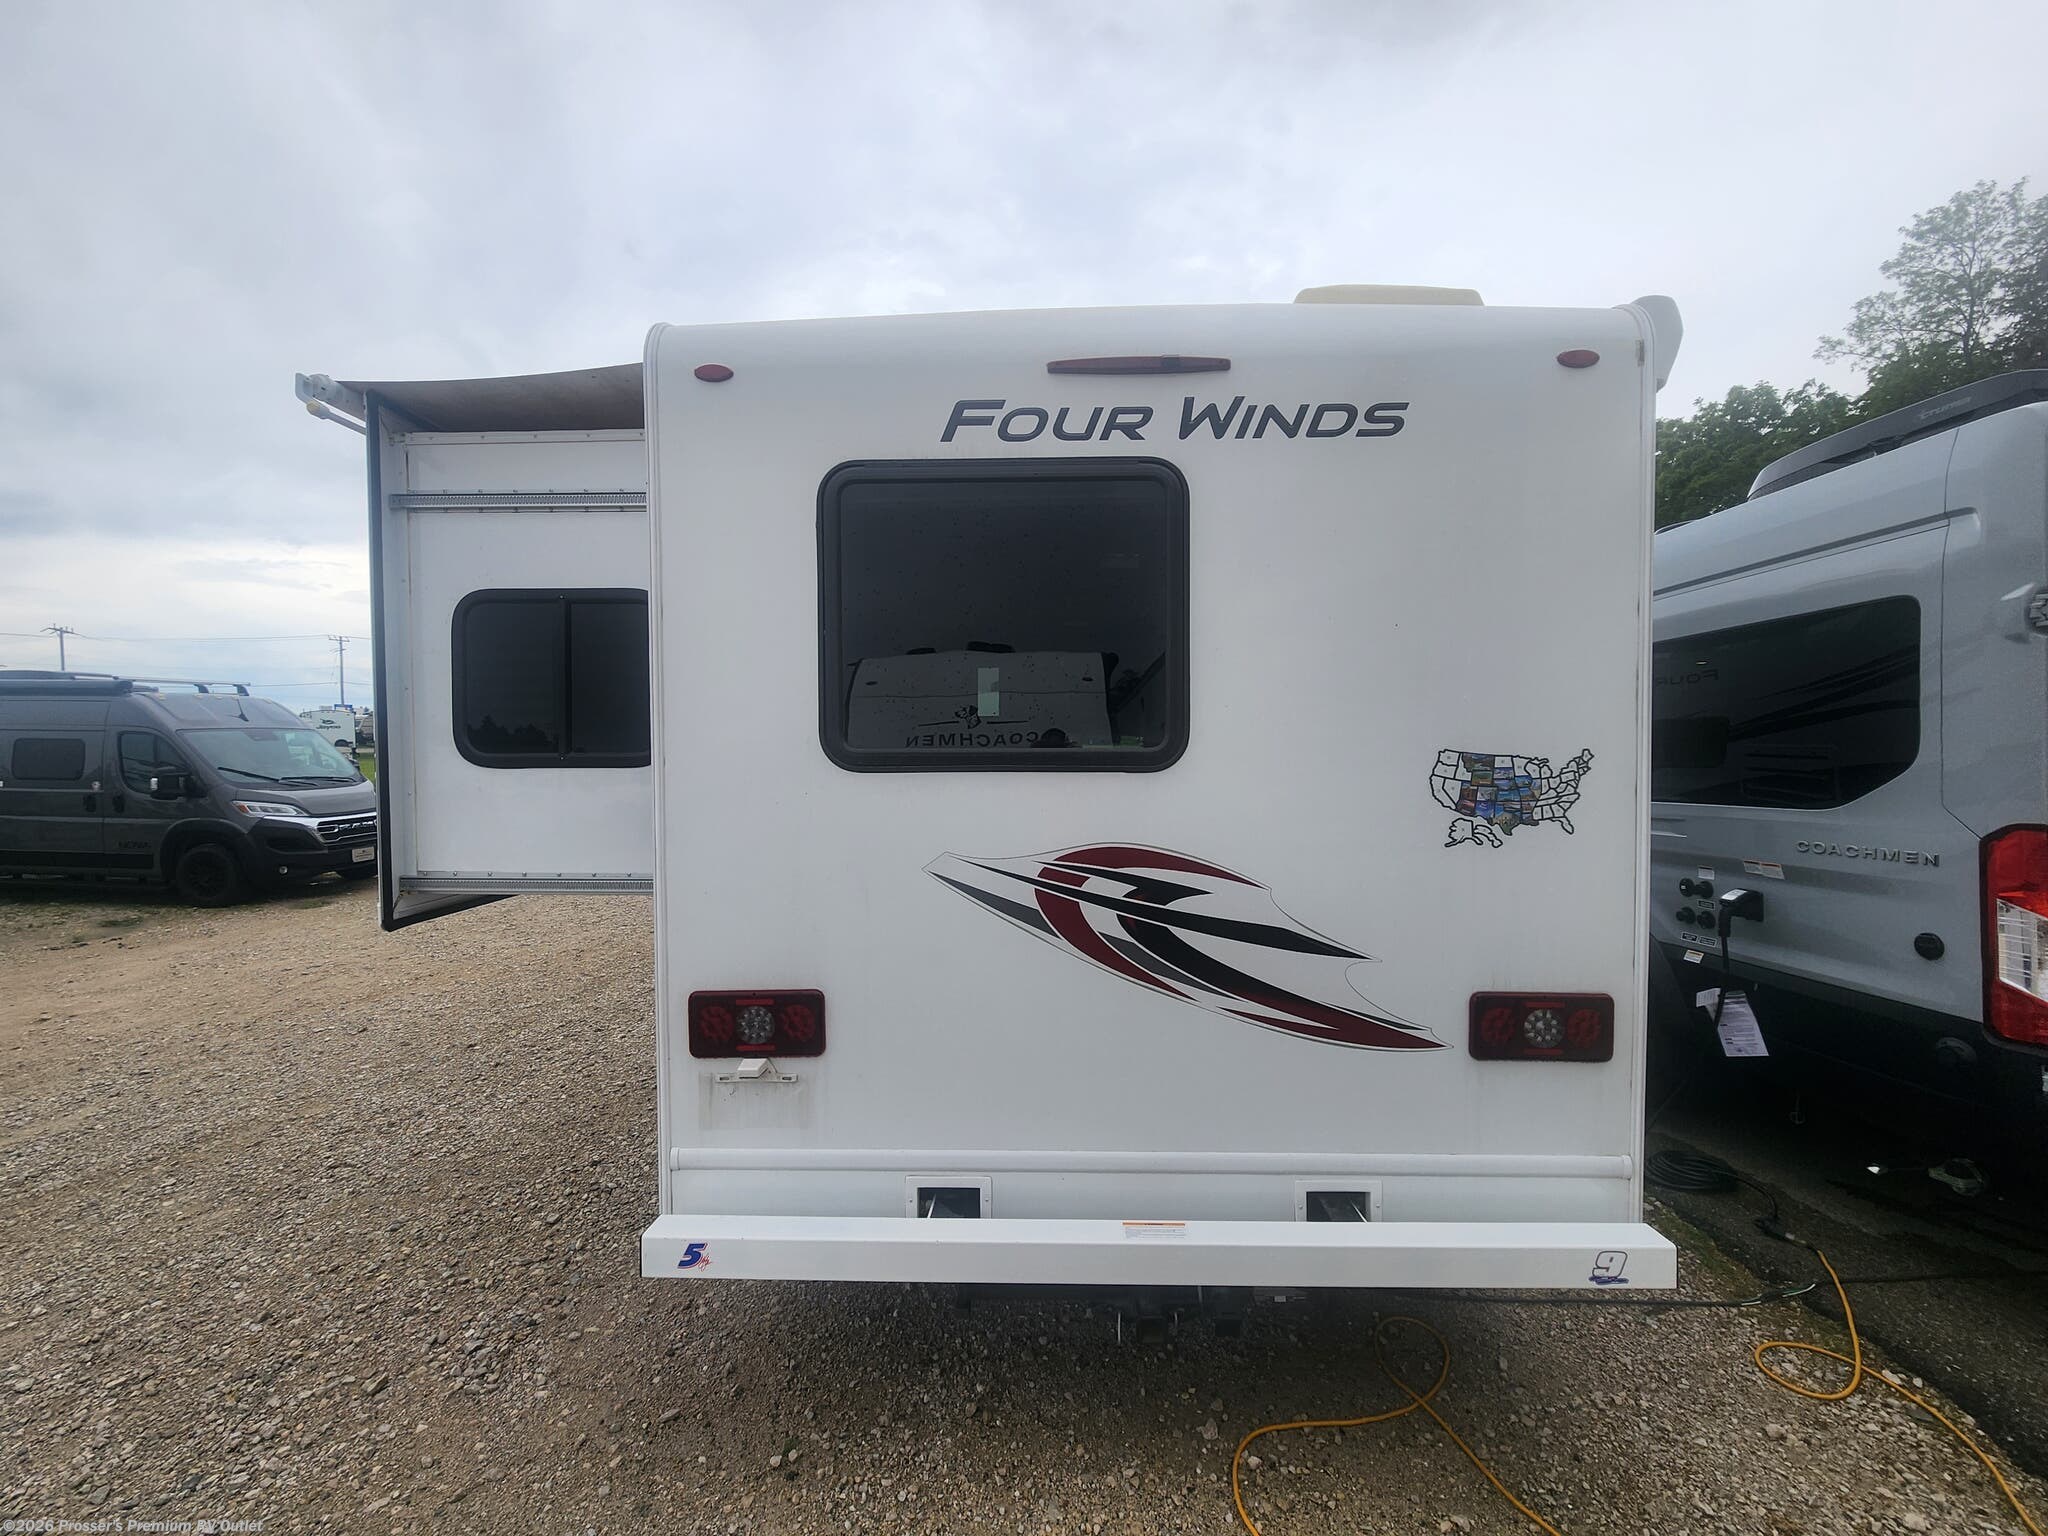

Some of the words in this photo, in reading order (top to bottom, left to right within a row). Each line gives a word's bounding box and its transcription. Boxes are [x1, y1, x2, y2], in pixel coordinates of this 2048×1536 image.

[1795, 839, 1941, 867] COACHMEN
[677, 1242, 709, 1270] 5
[1591, 1250, 1629, 1279] 9
